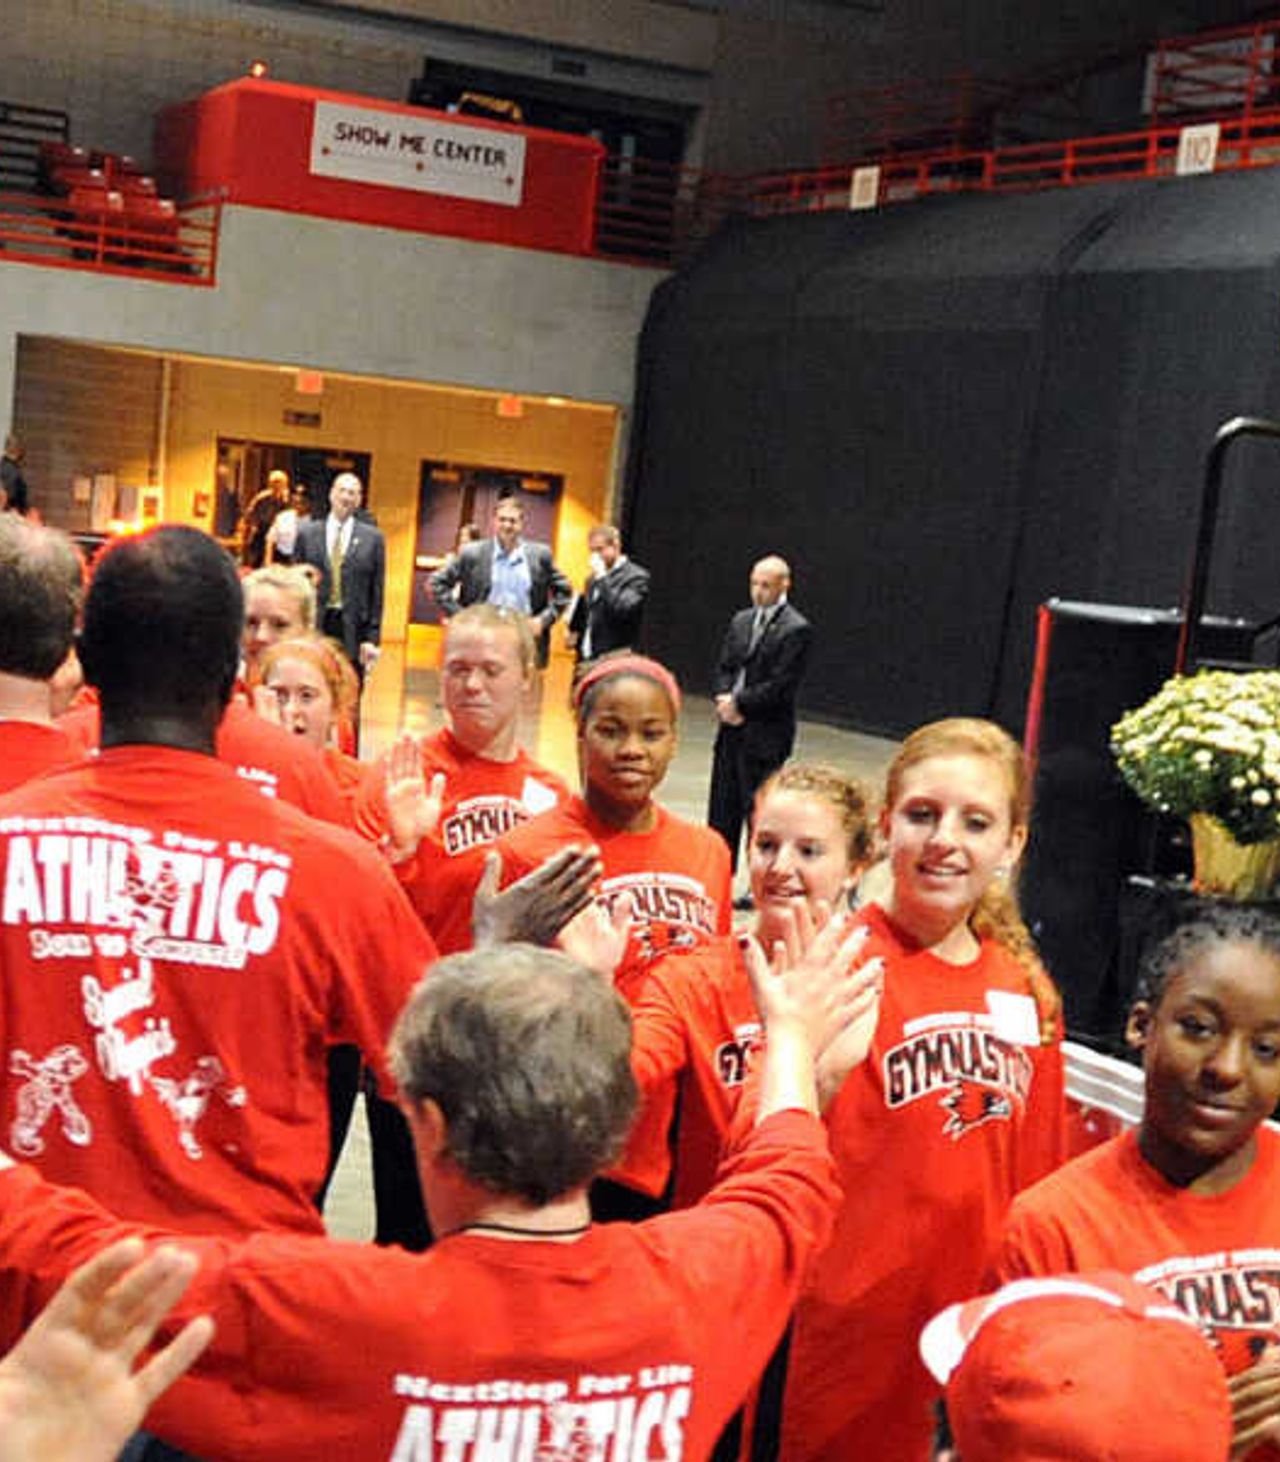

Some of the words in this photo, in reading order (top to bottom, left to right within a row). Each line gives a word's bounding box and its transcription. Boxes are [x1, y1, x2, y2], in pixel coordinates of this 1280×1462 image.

[334, 121, 391, 148] SHOW
[399, 133, 426, 155] ME
[433, 138, 507, 168] CENTER
